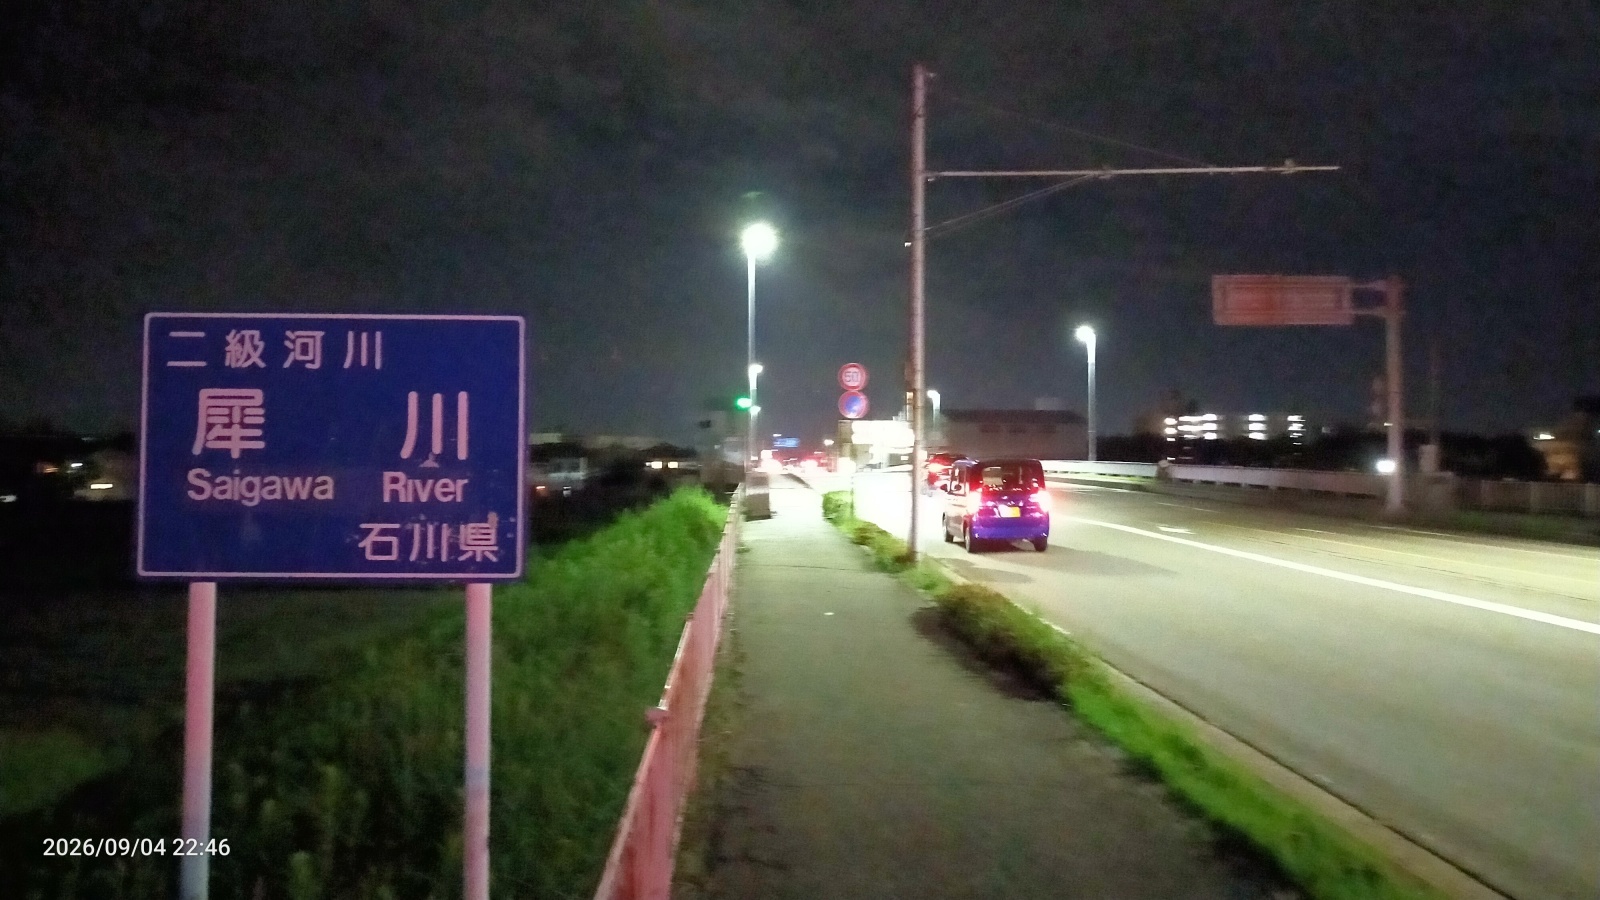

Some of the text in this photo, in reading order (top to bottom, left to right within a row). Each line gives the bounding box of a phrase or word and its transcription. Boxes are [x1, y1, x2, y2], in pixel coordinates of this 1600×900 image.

[167, 329, 383, 370] 二級河川
[400, 391, 469, 461] 川
[187, 468, 469, 506] Saigawa River
[358, 522, 499, 563] 石川県
